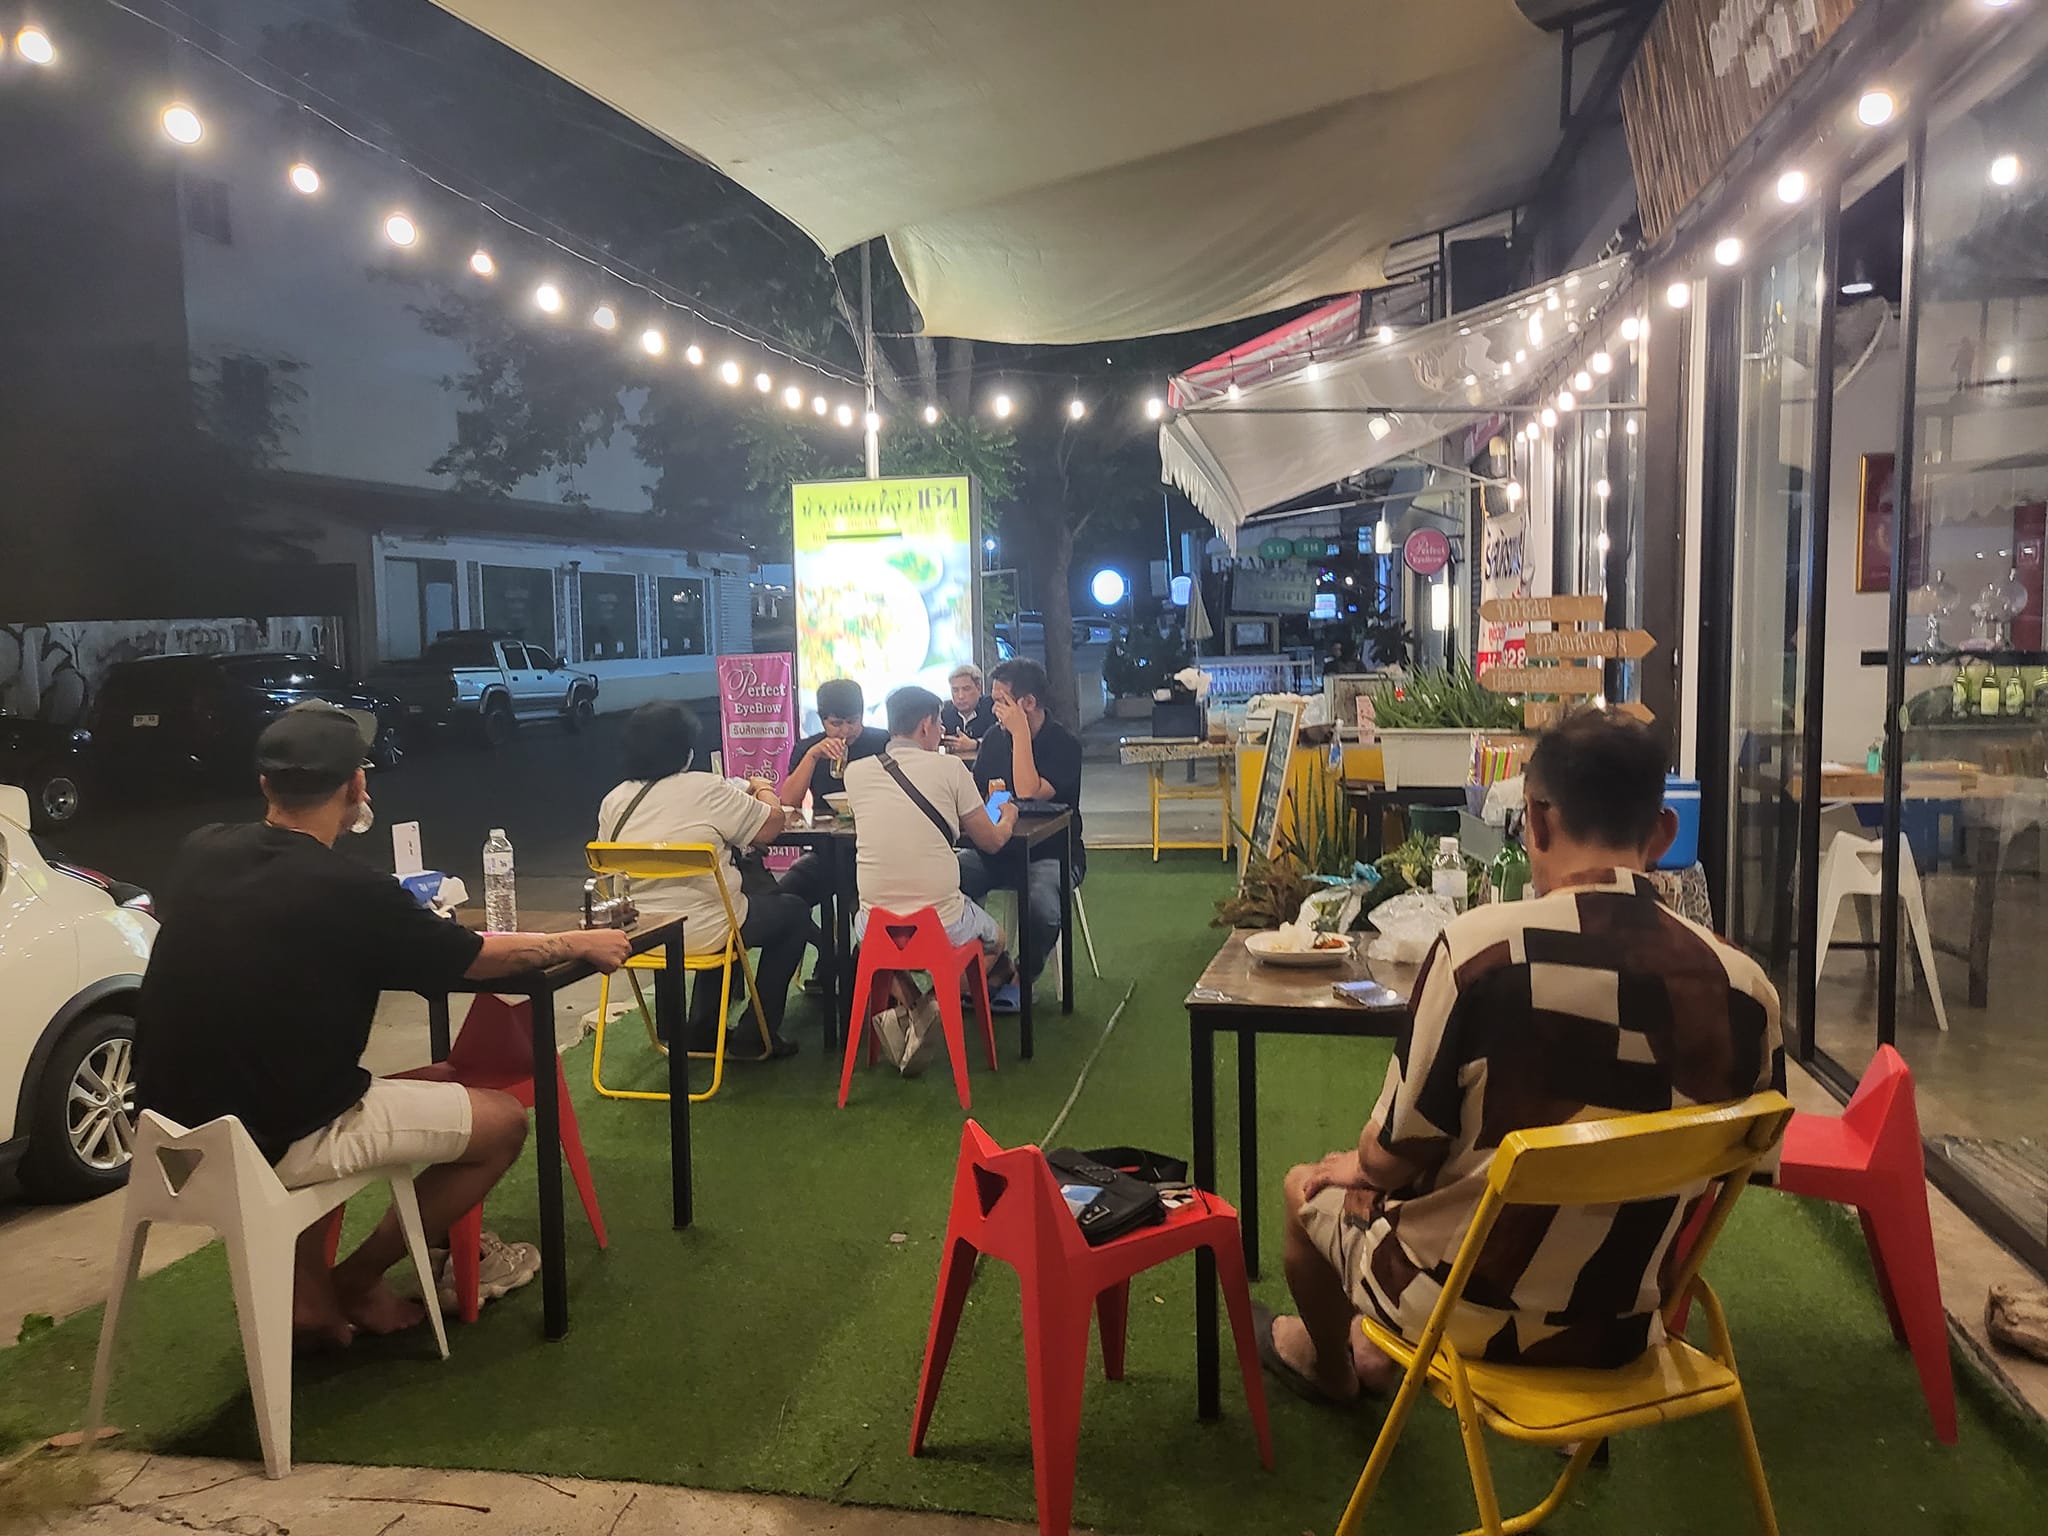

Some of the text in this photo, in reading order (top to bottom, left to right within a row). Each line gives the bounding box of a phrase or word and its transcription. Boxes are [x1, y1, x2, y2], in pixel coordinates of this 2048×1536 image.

[918, 487, 958, 511] 164
[726, 668, 786, 701] Perfect
[734, 702, 782, 717] EyeBrow
